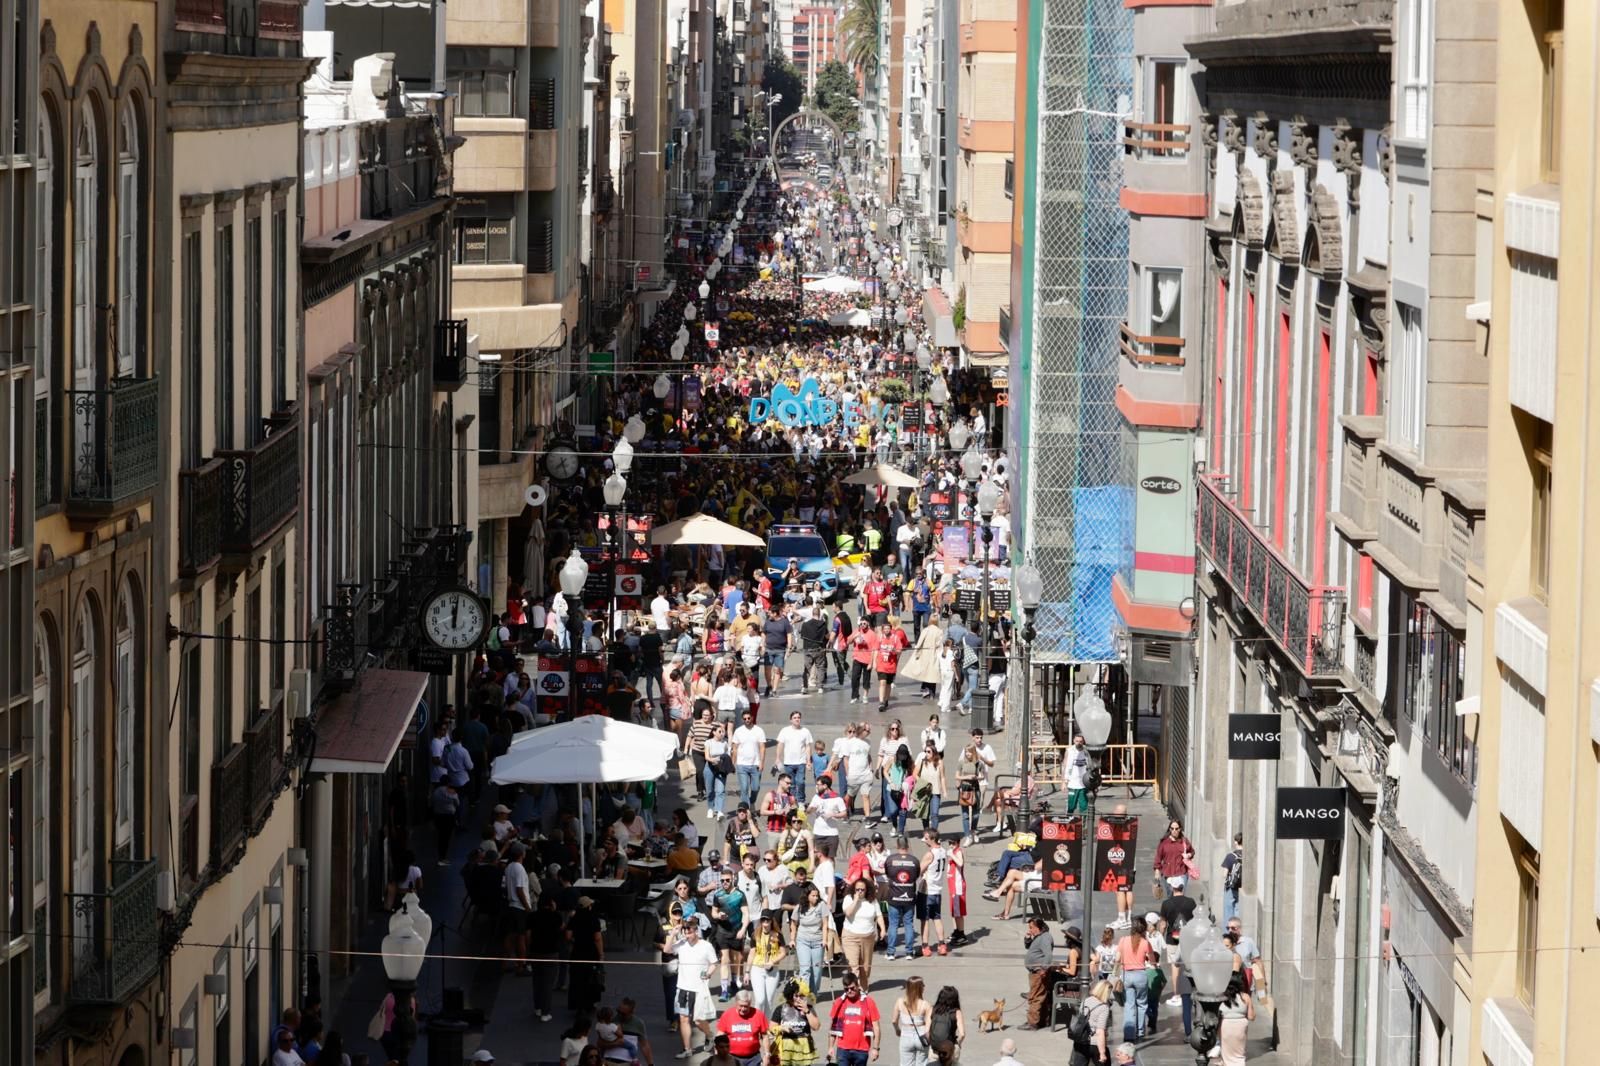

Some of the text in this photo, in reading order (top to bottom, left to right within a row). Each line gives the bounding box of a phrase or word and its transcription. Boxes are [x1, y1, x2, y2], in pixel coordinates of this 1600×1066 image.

[465, 226, 508, 235] GINECLOGIA
[1142, 480, 1180, 491] cortés
[1282, 808, 1340, 819] MANGO
